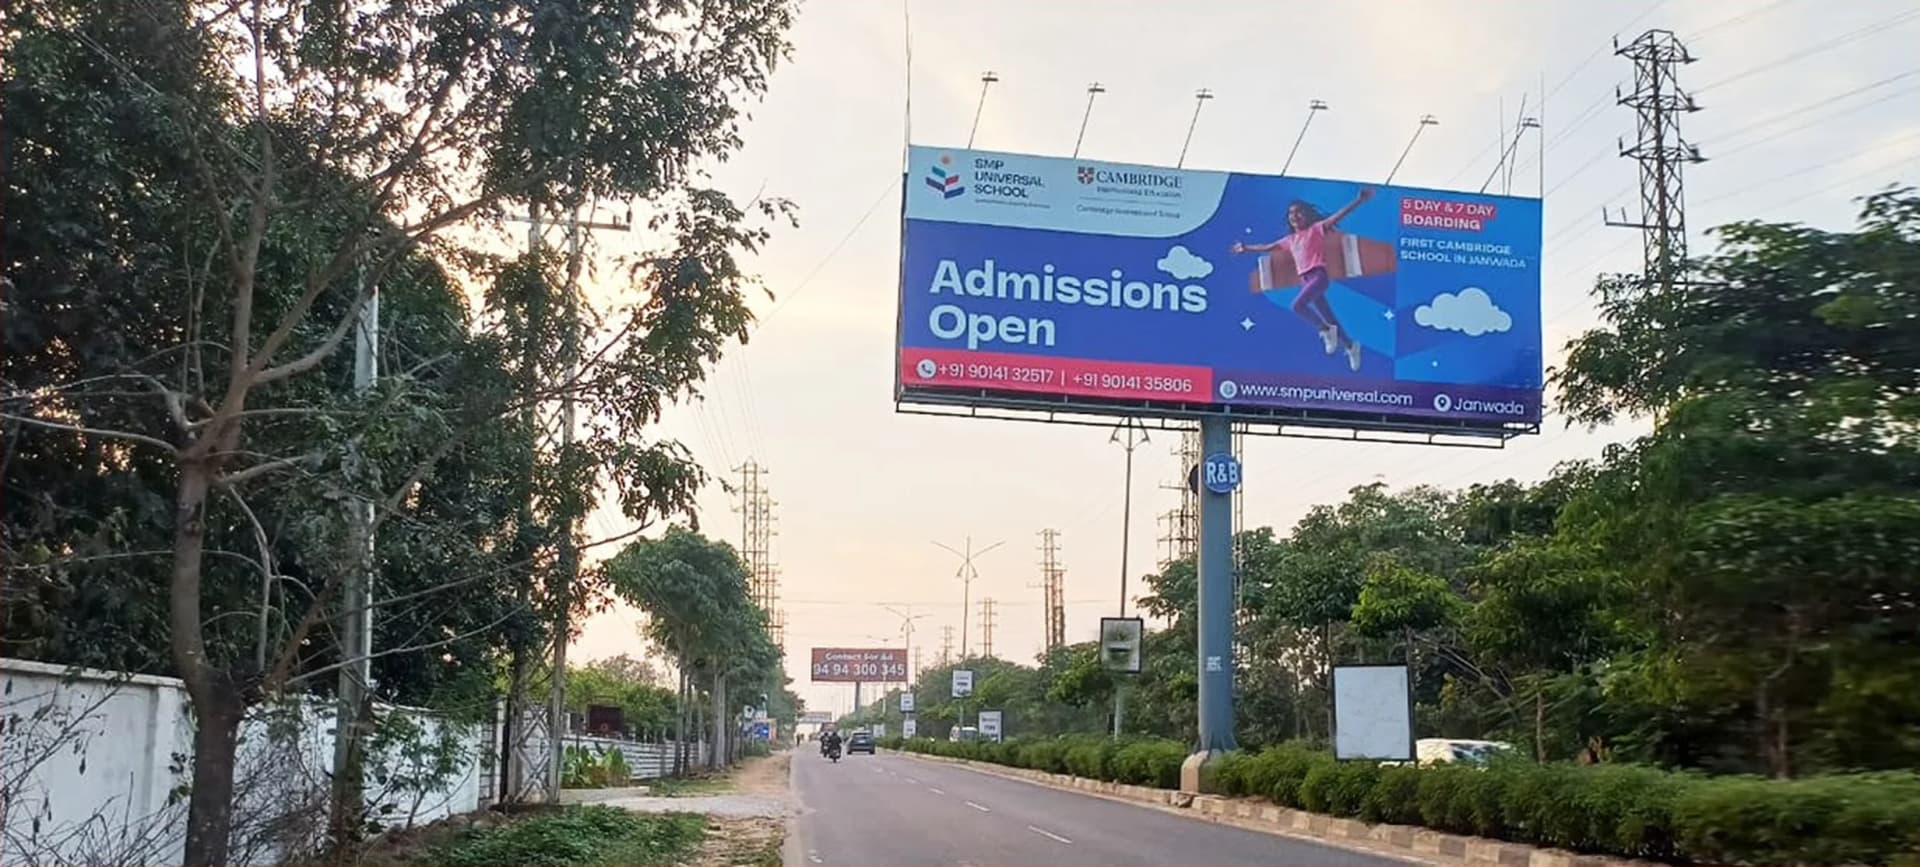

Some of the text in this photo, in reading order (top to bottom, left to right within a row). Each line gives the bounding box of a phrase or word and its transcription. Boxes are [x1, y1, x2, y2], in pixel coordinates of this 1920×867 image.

[974, 158, 1004, 170] SMP
[975, 171, 1045, 188] UNIVERSAL
[1096, 170, 1183, 189] CAMBRIDGE
[974, 184, 1029, 199] SCHOOL
[1403, 199, 1494, 216] 5 DAY & 7 DAY
[1403, 214, 1481, 230] BOARDING
[1401, 237, 1512, 255] FIRST CAMBRIDGE
[1401, 250, 1527, 269] SCHOOL IN JANWADA
[929, 259, 1208, 313] Admissions
[929, 304, 1055, 350] Open
[939, 363, 964, 378] +91
[968, 364, 1009, 381] 90141
[1012, 367, 1055, 383] 32517
[1073, 373, 1098, 387] +91
[1101, 374, 1141, 390] 90141
[1143, 376, 1193, 392] 35806
[1240, 383, 1413, 407] www.smpuniversal.com
[1454, 397, 1525, 415] Janwada
[1206, 461, 1238, 484] R&B
[833, 663, 849, 676] 94
[852, 663, 877, 676] 300
[881, 663, 905, 677] 345
